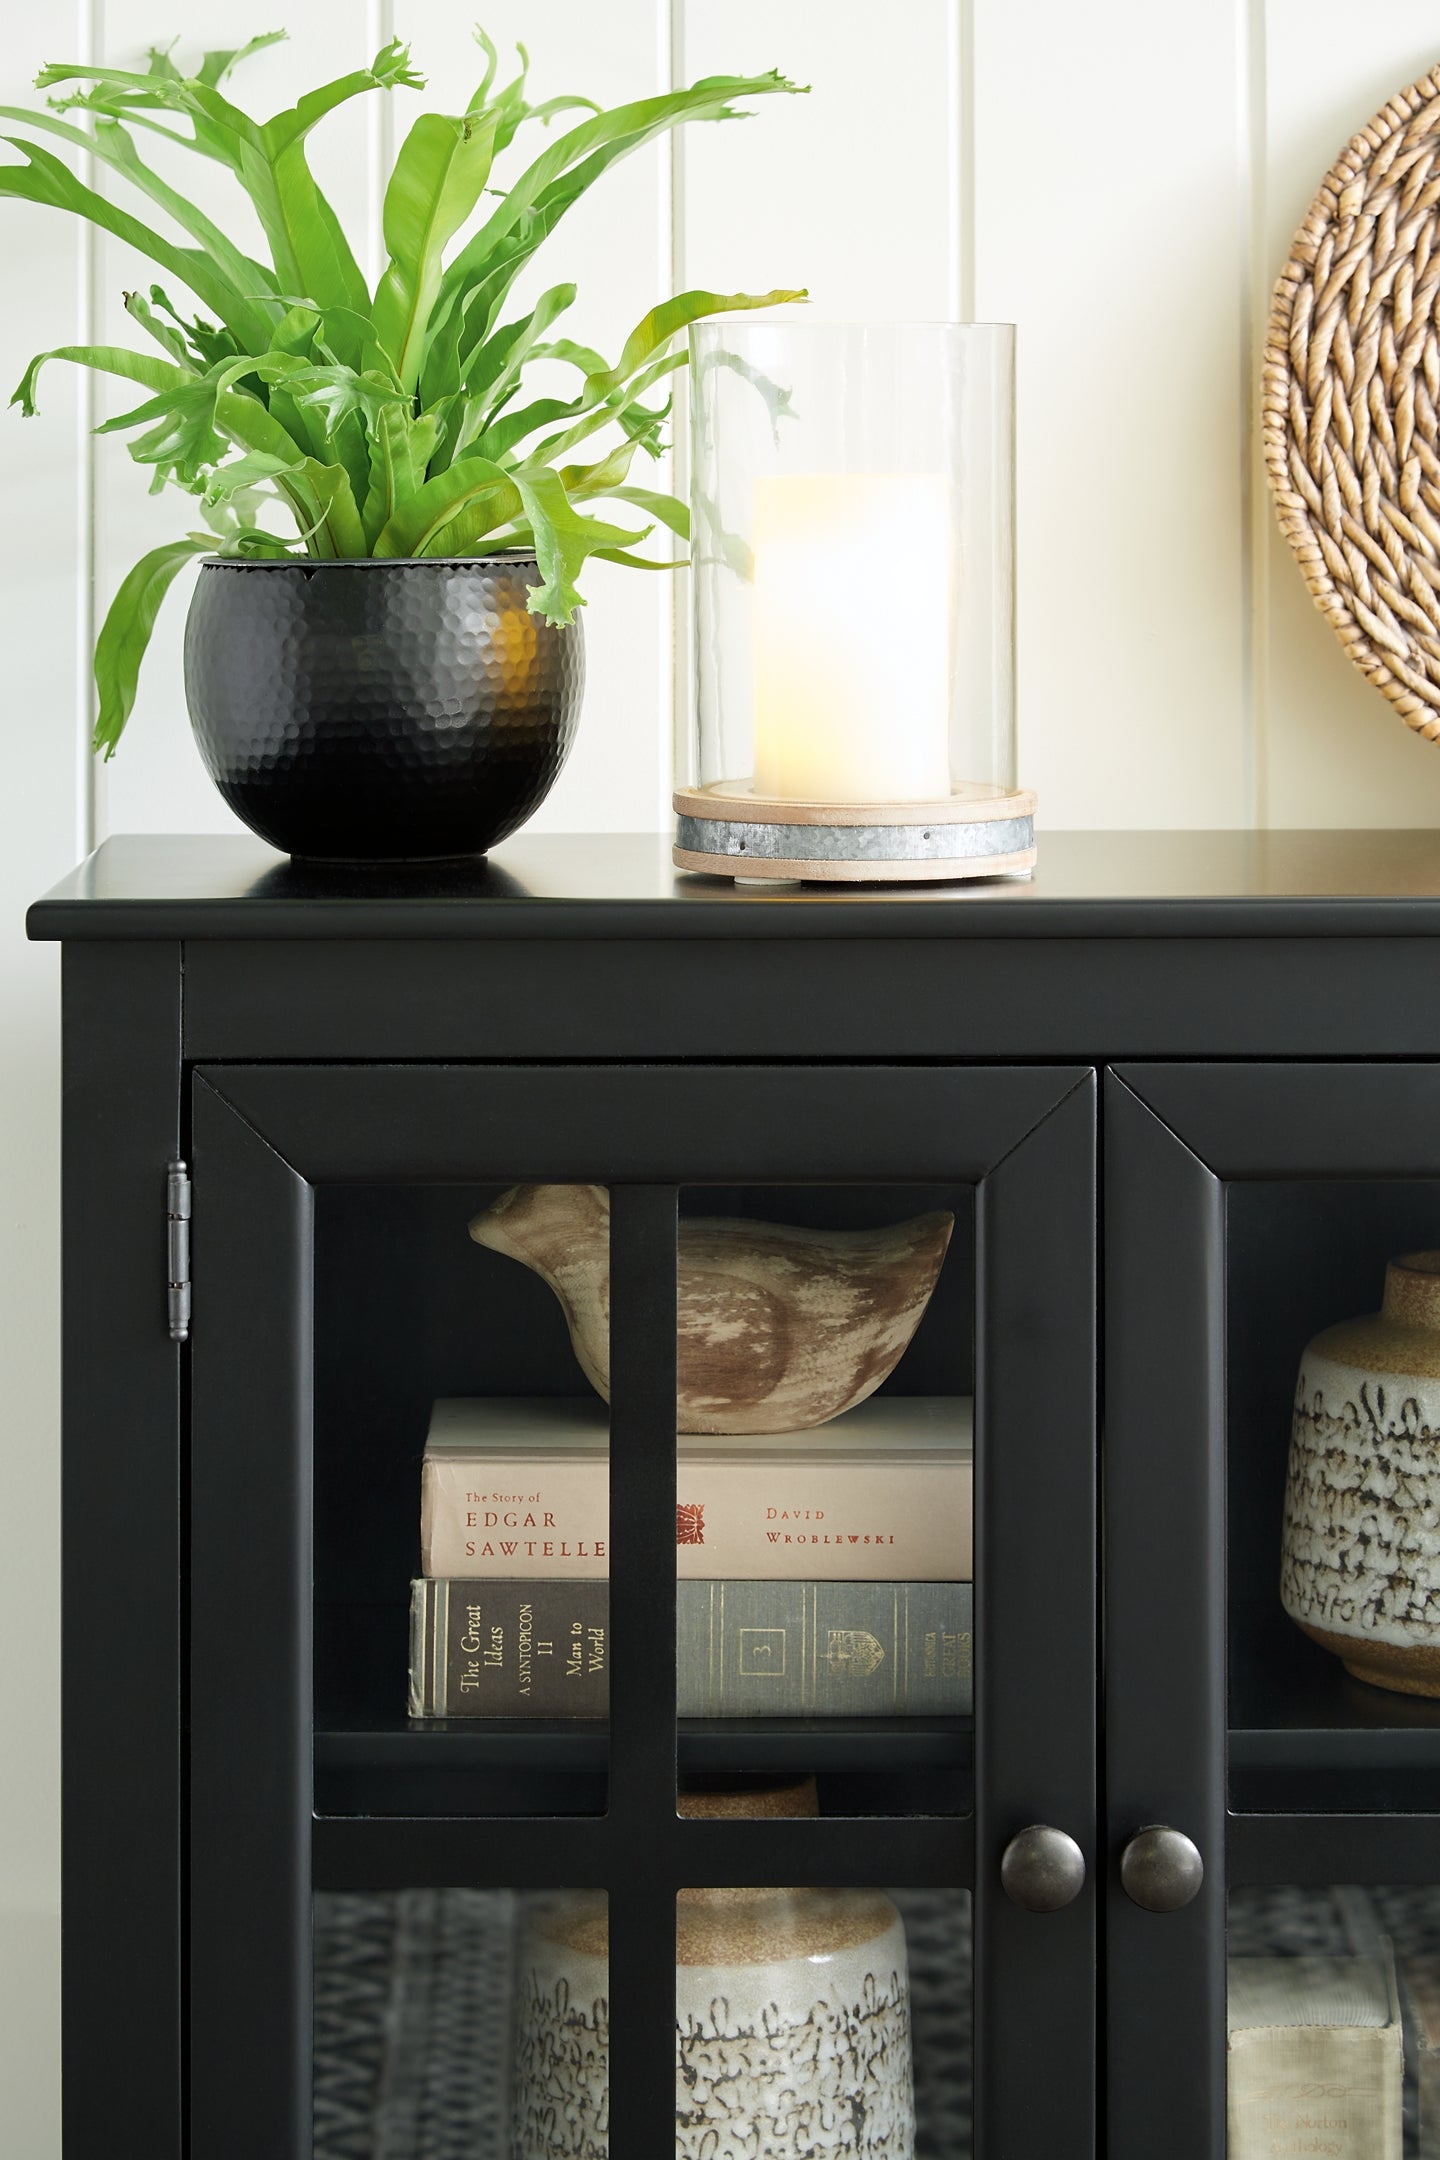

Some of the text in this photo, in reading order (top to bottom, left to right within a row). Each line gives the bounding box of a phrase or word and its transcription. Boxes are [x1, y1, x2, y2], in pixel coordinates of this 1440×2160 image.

[466, 1492, 541, 1505] The Story of
[466, 1512, 556, 1527] EDGAR
[766, 1508, 825, 1520] DAVID
[766, 1532, 895, 1544] WROBLEWSKI
[466, 1541, 606, 1557] SAWTELLE
[460, 1605, 481, 1693] The Great
[484, 1626, 504, 1667] Ideas
[518, 1604, 532, 1696] A SYNTOPICON
[537, 1641, 553, 1655] II
[566, 1622, 582, 1677] Man to
[588, 1628, 605, 1672] World
[753, 1645, 771, 1657] 3
